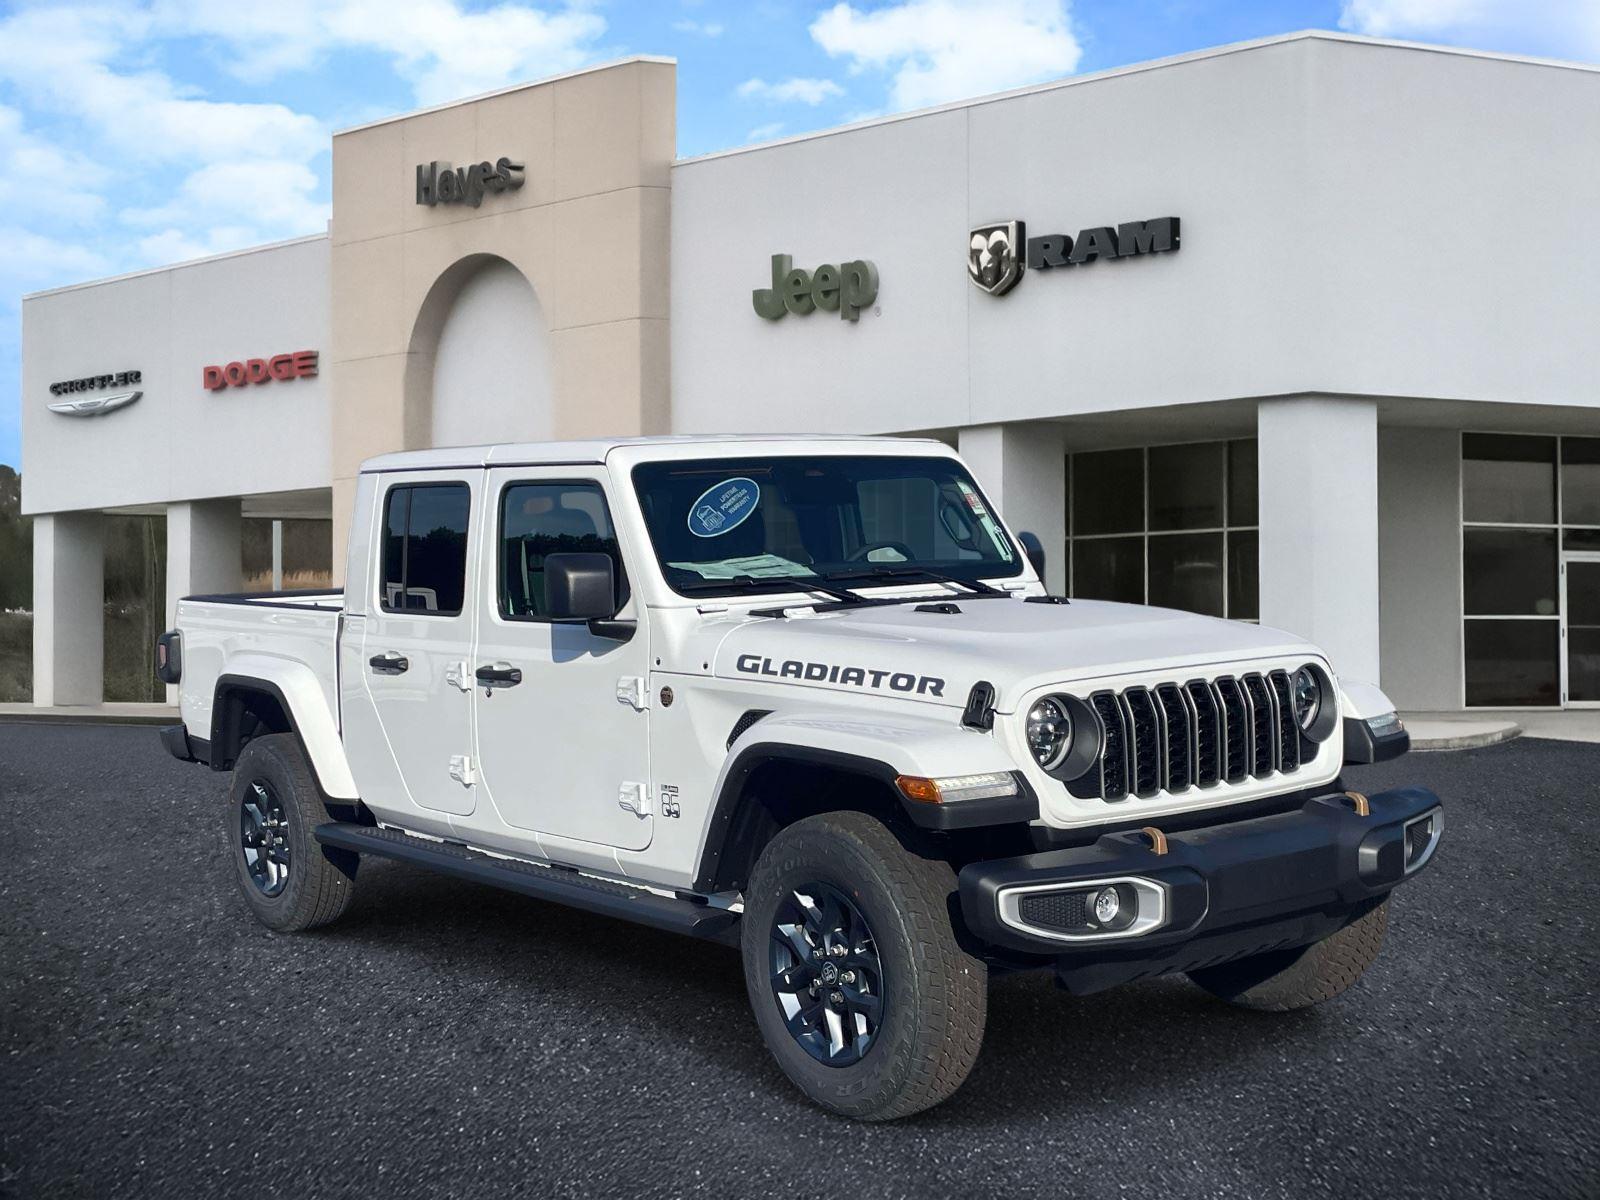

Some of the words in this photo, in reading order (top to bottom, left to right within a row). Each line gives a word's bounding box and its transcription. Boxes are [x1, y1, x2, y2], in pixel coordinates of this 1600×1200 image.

[416, 157, 525, 209] Hayes
[1028, 217, 1181, 270] RAM
[752, 254, 879, 321] Jeep
[49, 370, 142, 396] CHRYSLER
[203, 350, 319, 391] DODGE
[736, 653, 946, 698] GLADIATOR
